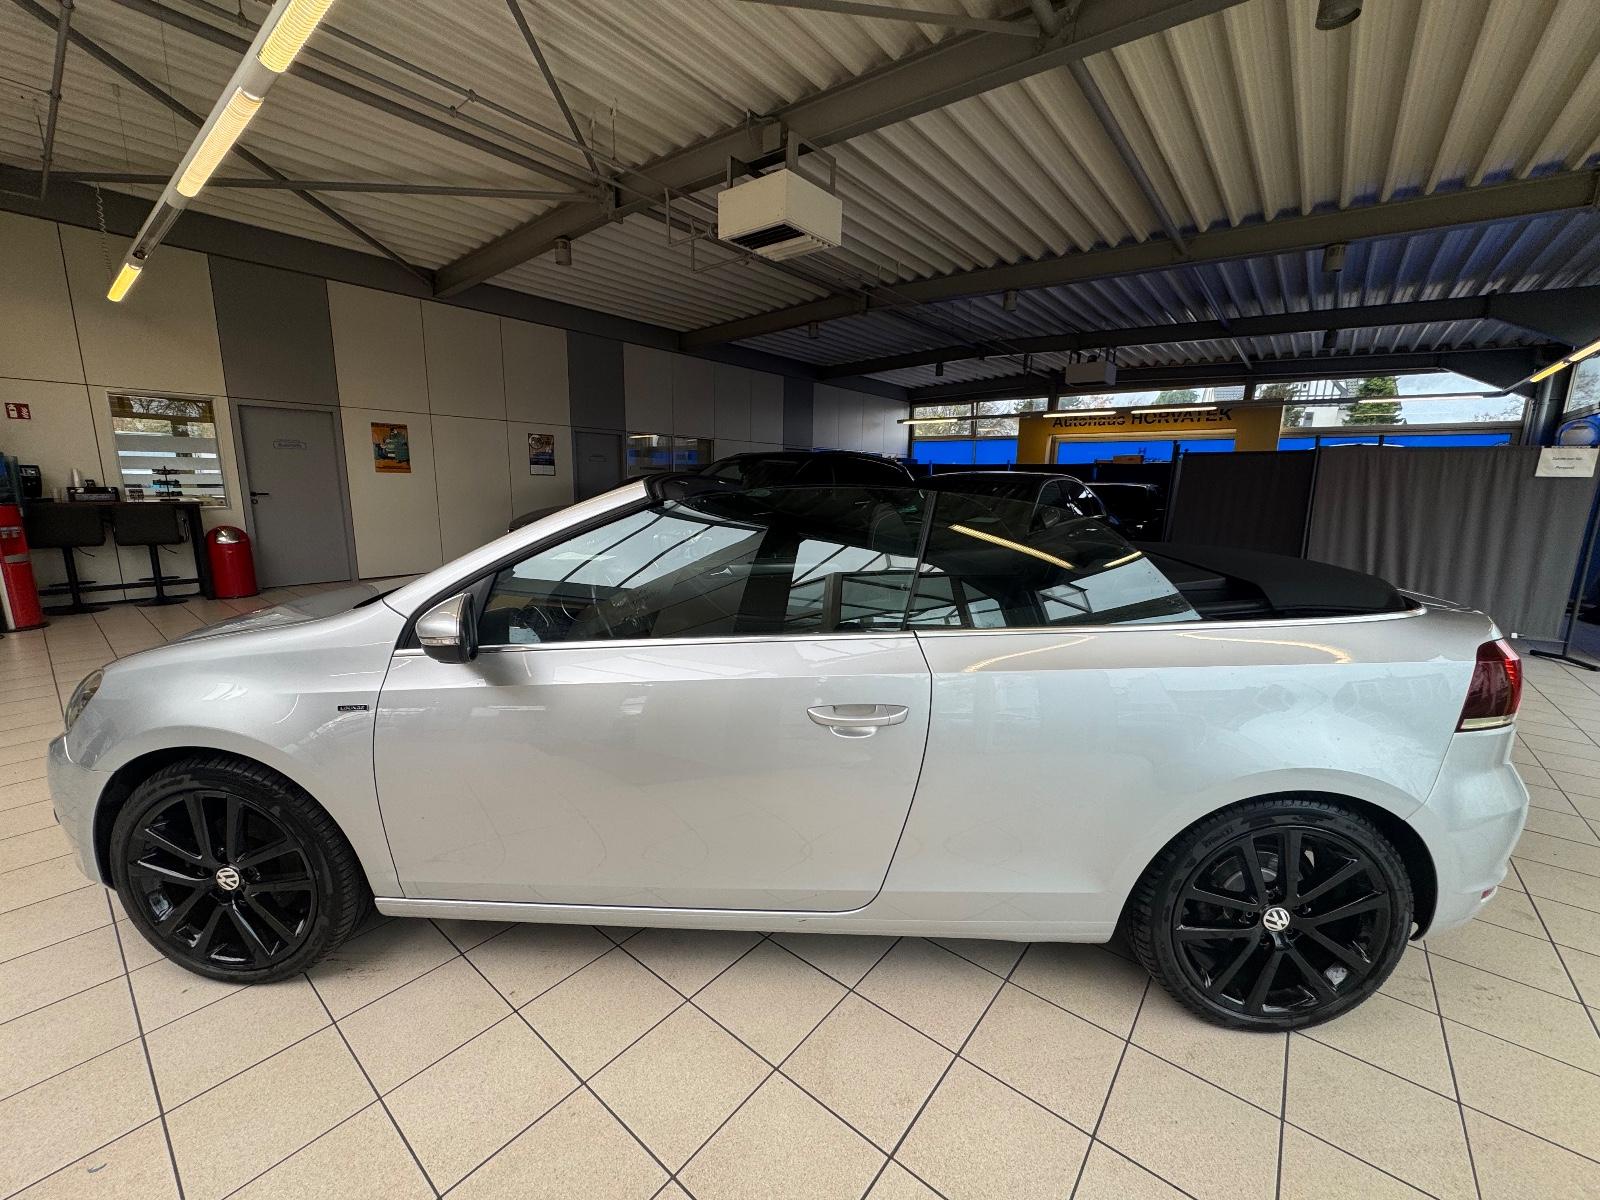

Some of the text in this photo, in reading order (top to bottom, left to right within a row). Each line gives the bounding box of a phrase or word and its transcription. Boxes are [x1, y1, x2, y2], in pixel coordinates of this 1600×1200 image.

[1052, 408, 1233, 428] Autohaus HORVATEK
[216, 867, 240, 891] VW
[1263, 907, 1290, 931] VW
